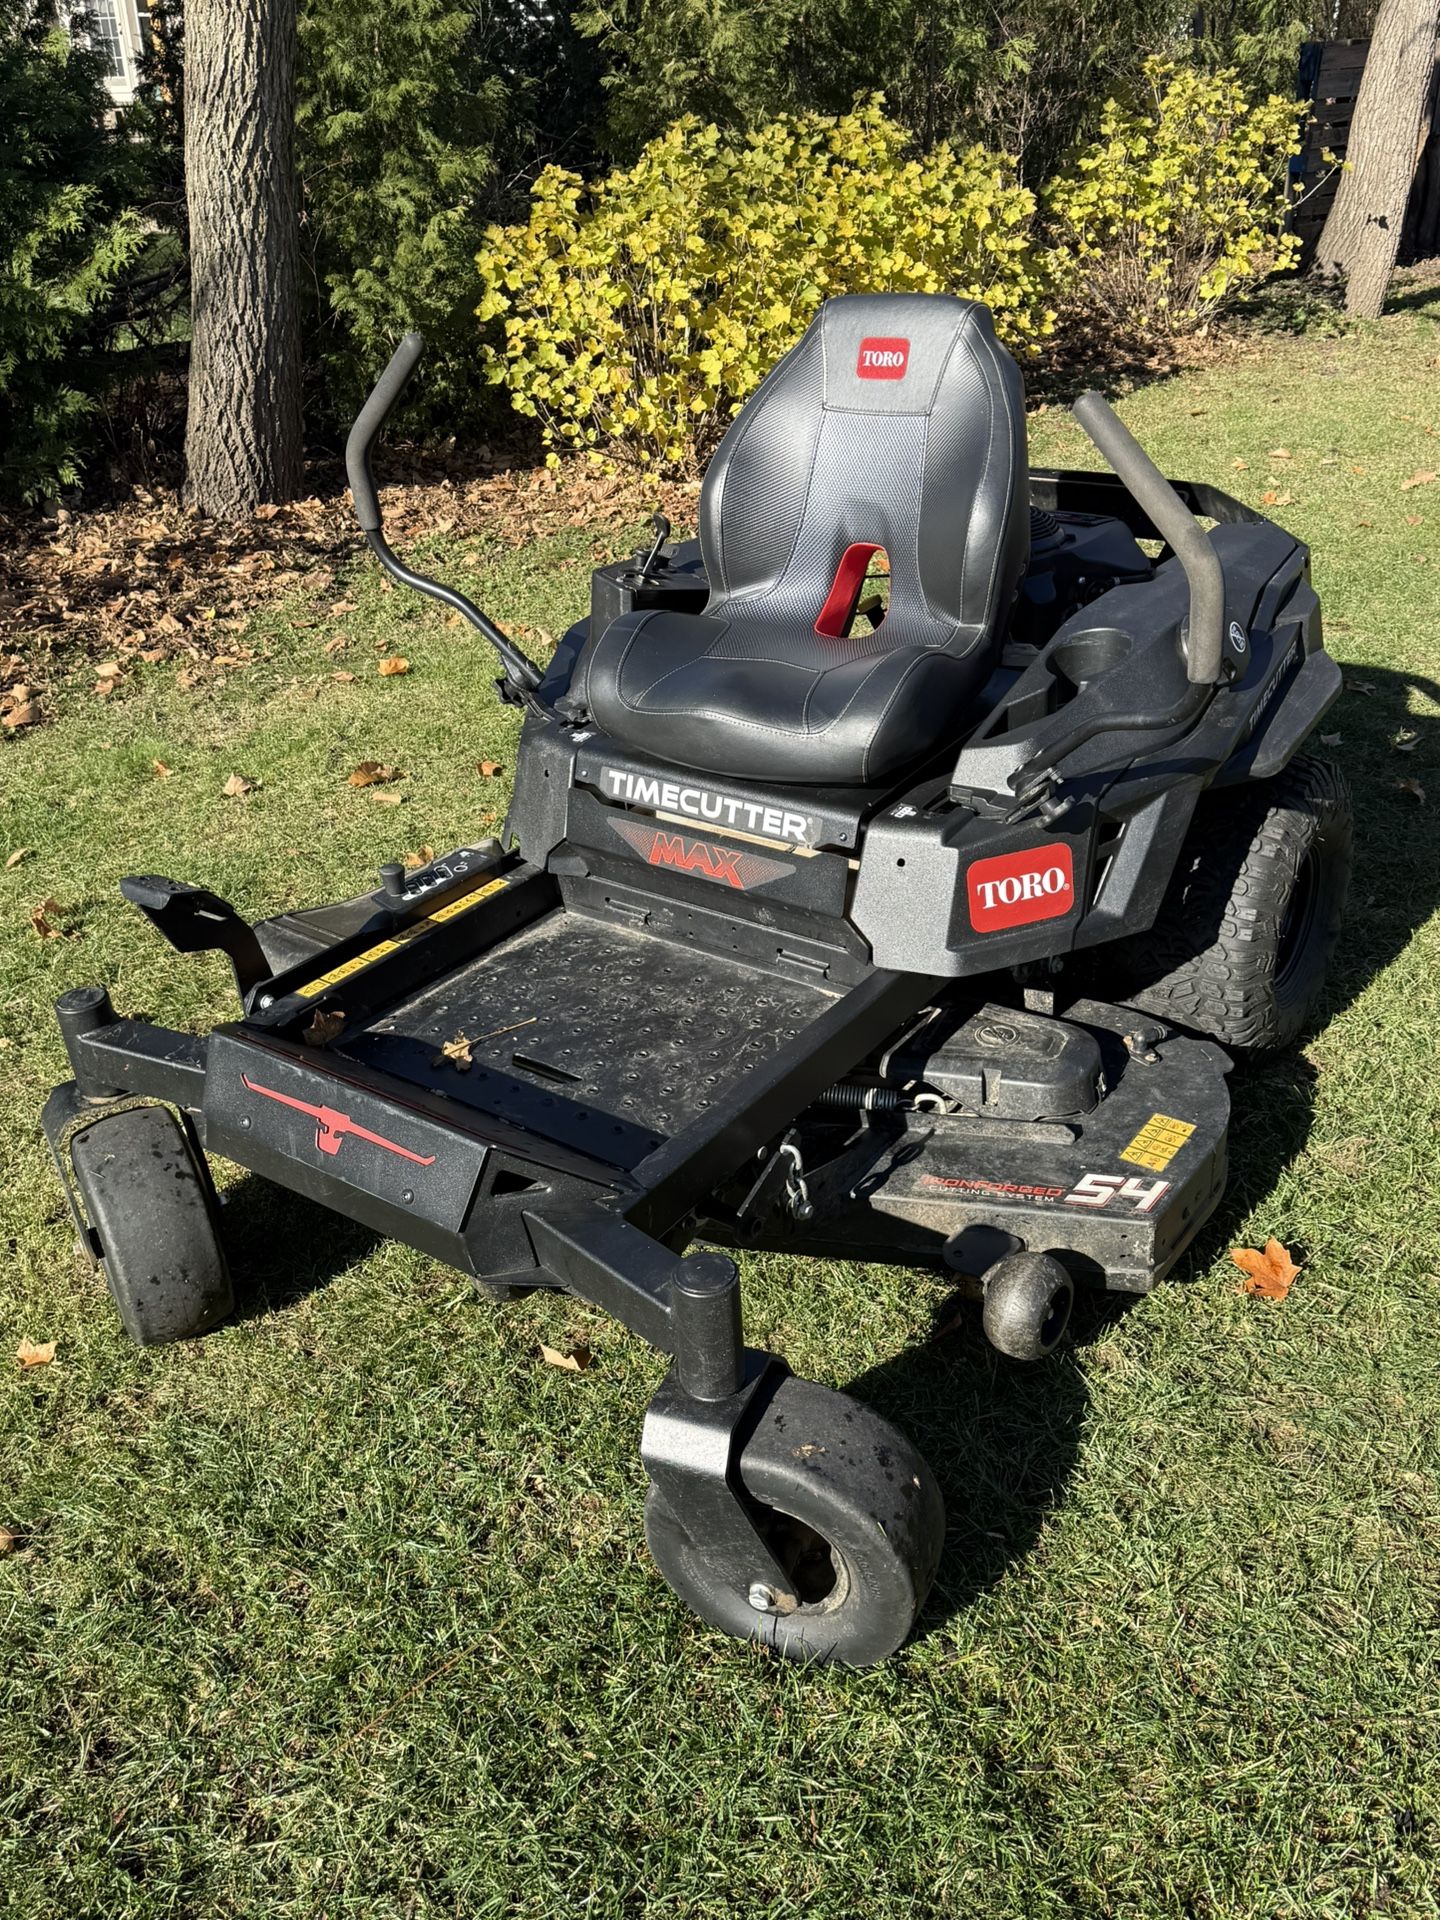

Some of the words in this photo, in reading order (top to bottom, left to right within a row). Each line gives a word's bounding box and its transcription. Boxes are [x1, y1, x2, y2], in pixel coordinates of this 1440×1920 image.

[863, 350, 904, 367] TORO
[608, 769, 808, 842] TIMECUTTER
[650, 831, 745, 890] MAX
[976, 867, 1066, 910] TORO
[921, 1174, 1064, 1196] IRONFORGED
[1064, 1173, 1171, 1213] 54
[928, 1184, 991, 1196] CUTTING
[996, 1190, 1055, 1202] SYSTEM
